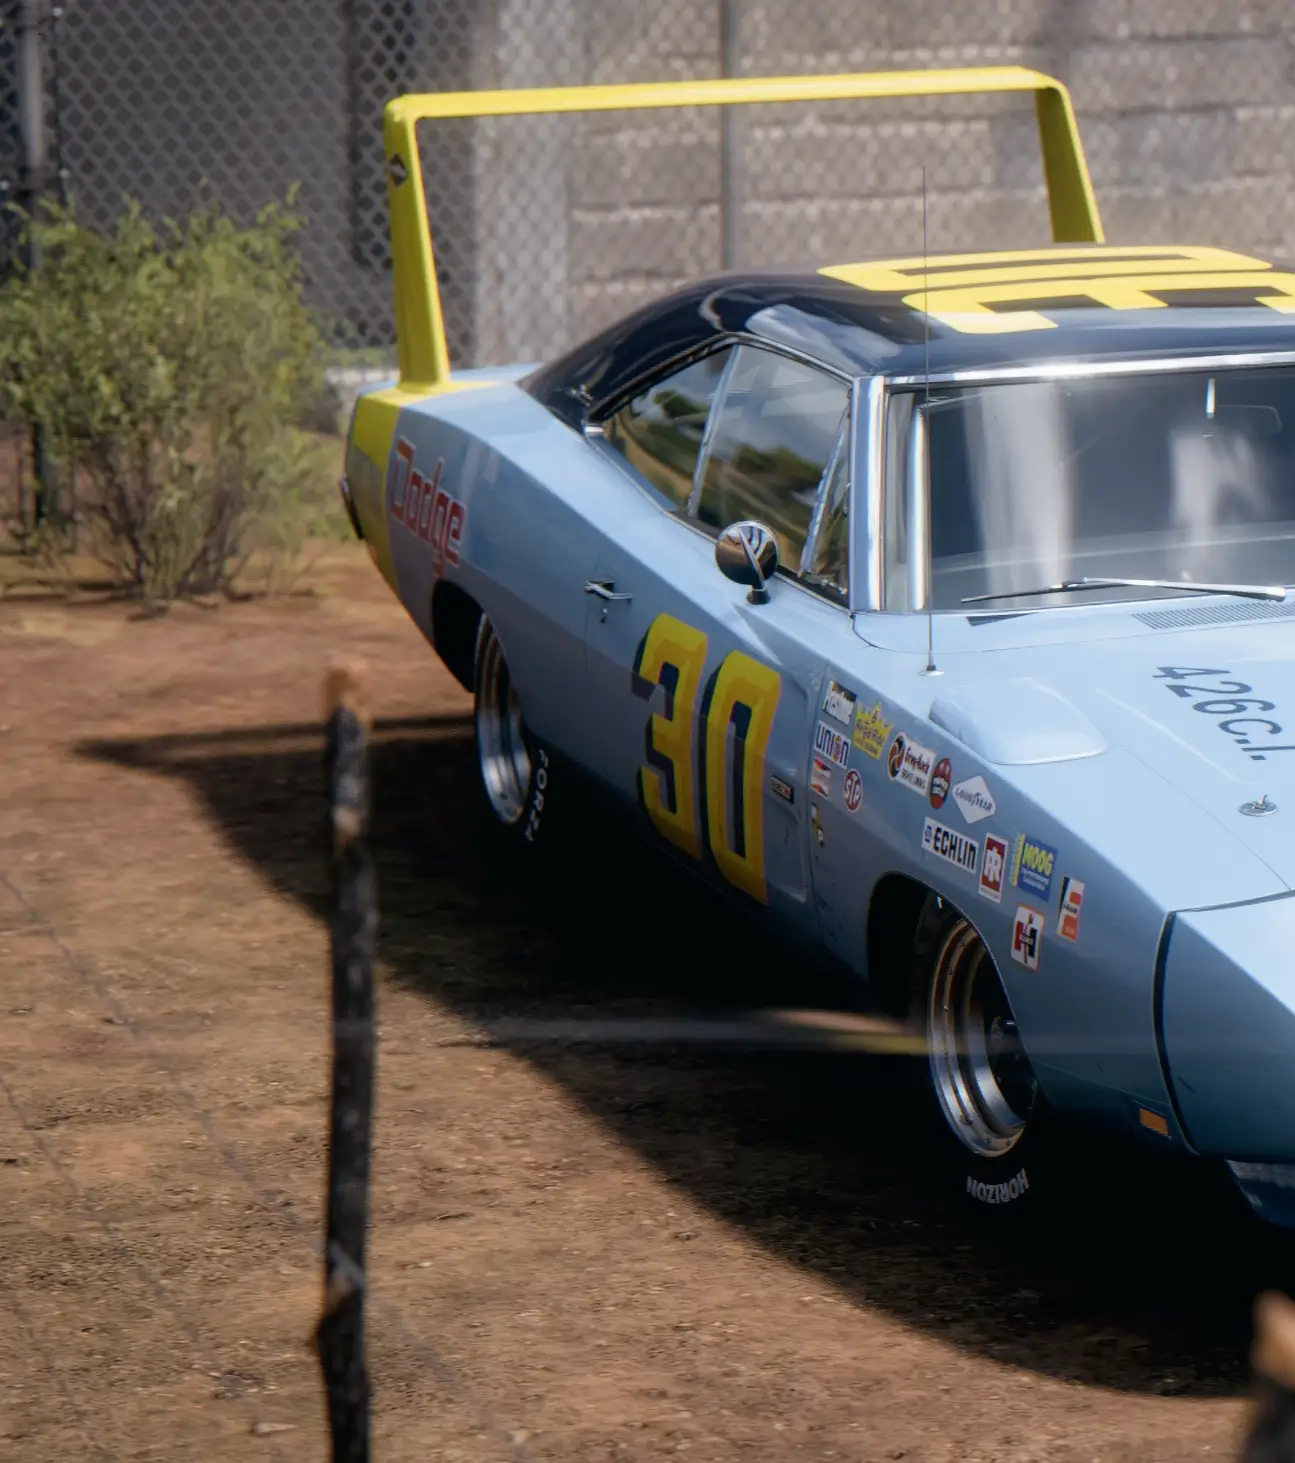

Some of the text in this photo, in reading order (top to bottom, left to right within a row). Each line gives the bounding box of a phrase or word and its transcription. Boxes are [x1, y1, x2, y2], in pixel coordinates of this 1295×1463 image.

[389, 435, 466, 577] Dodge
[631, 611, 781, 907] 30
[933, 826, 977, 871] ECHLIN
[1022, 843, 1055, 877] MOOG
[966, 1167, 1030, 1204] HORIZON
